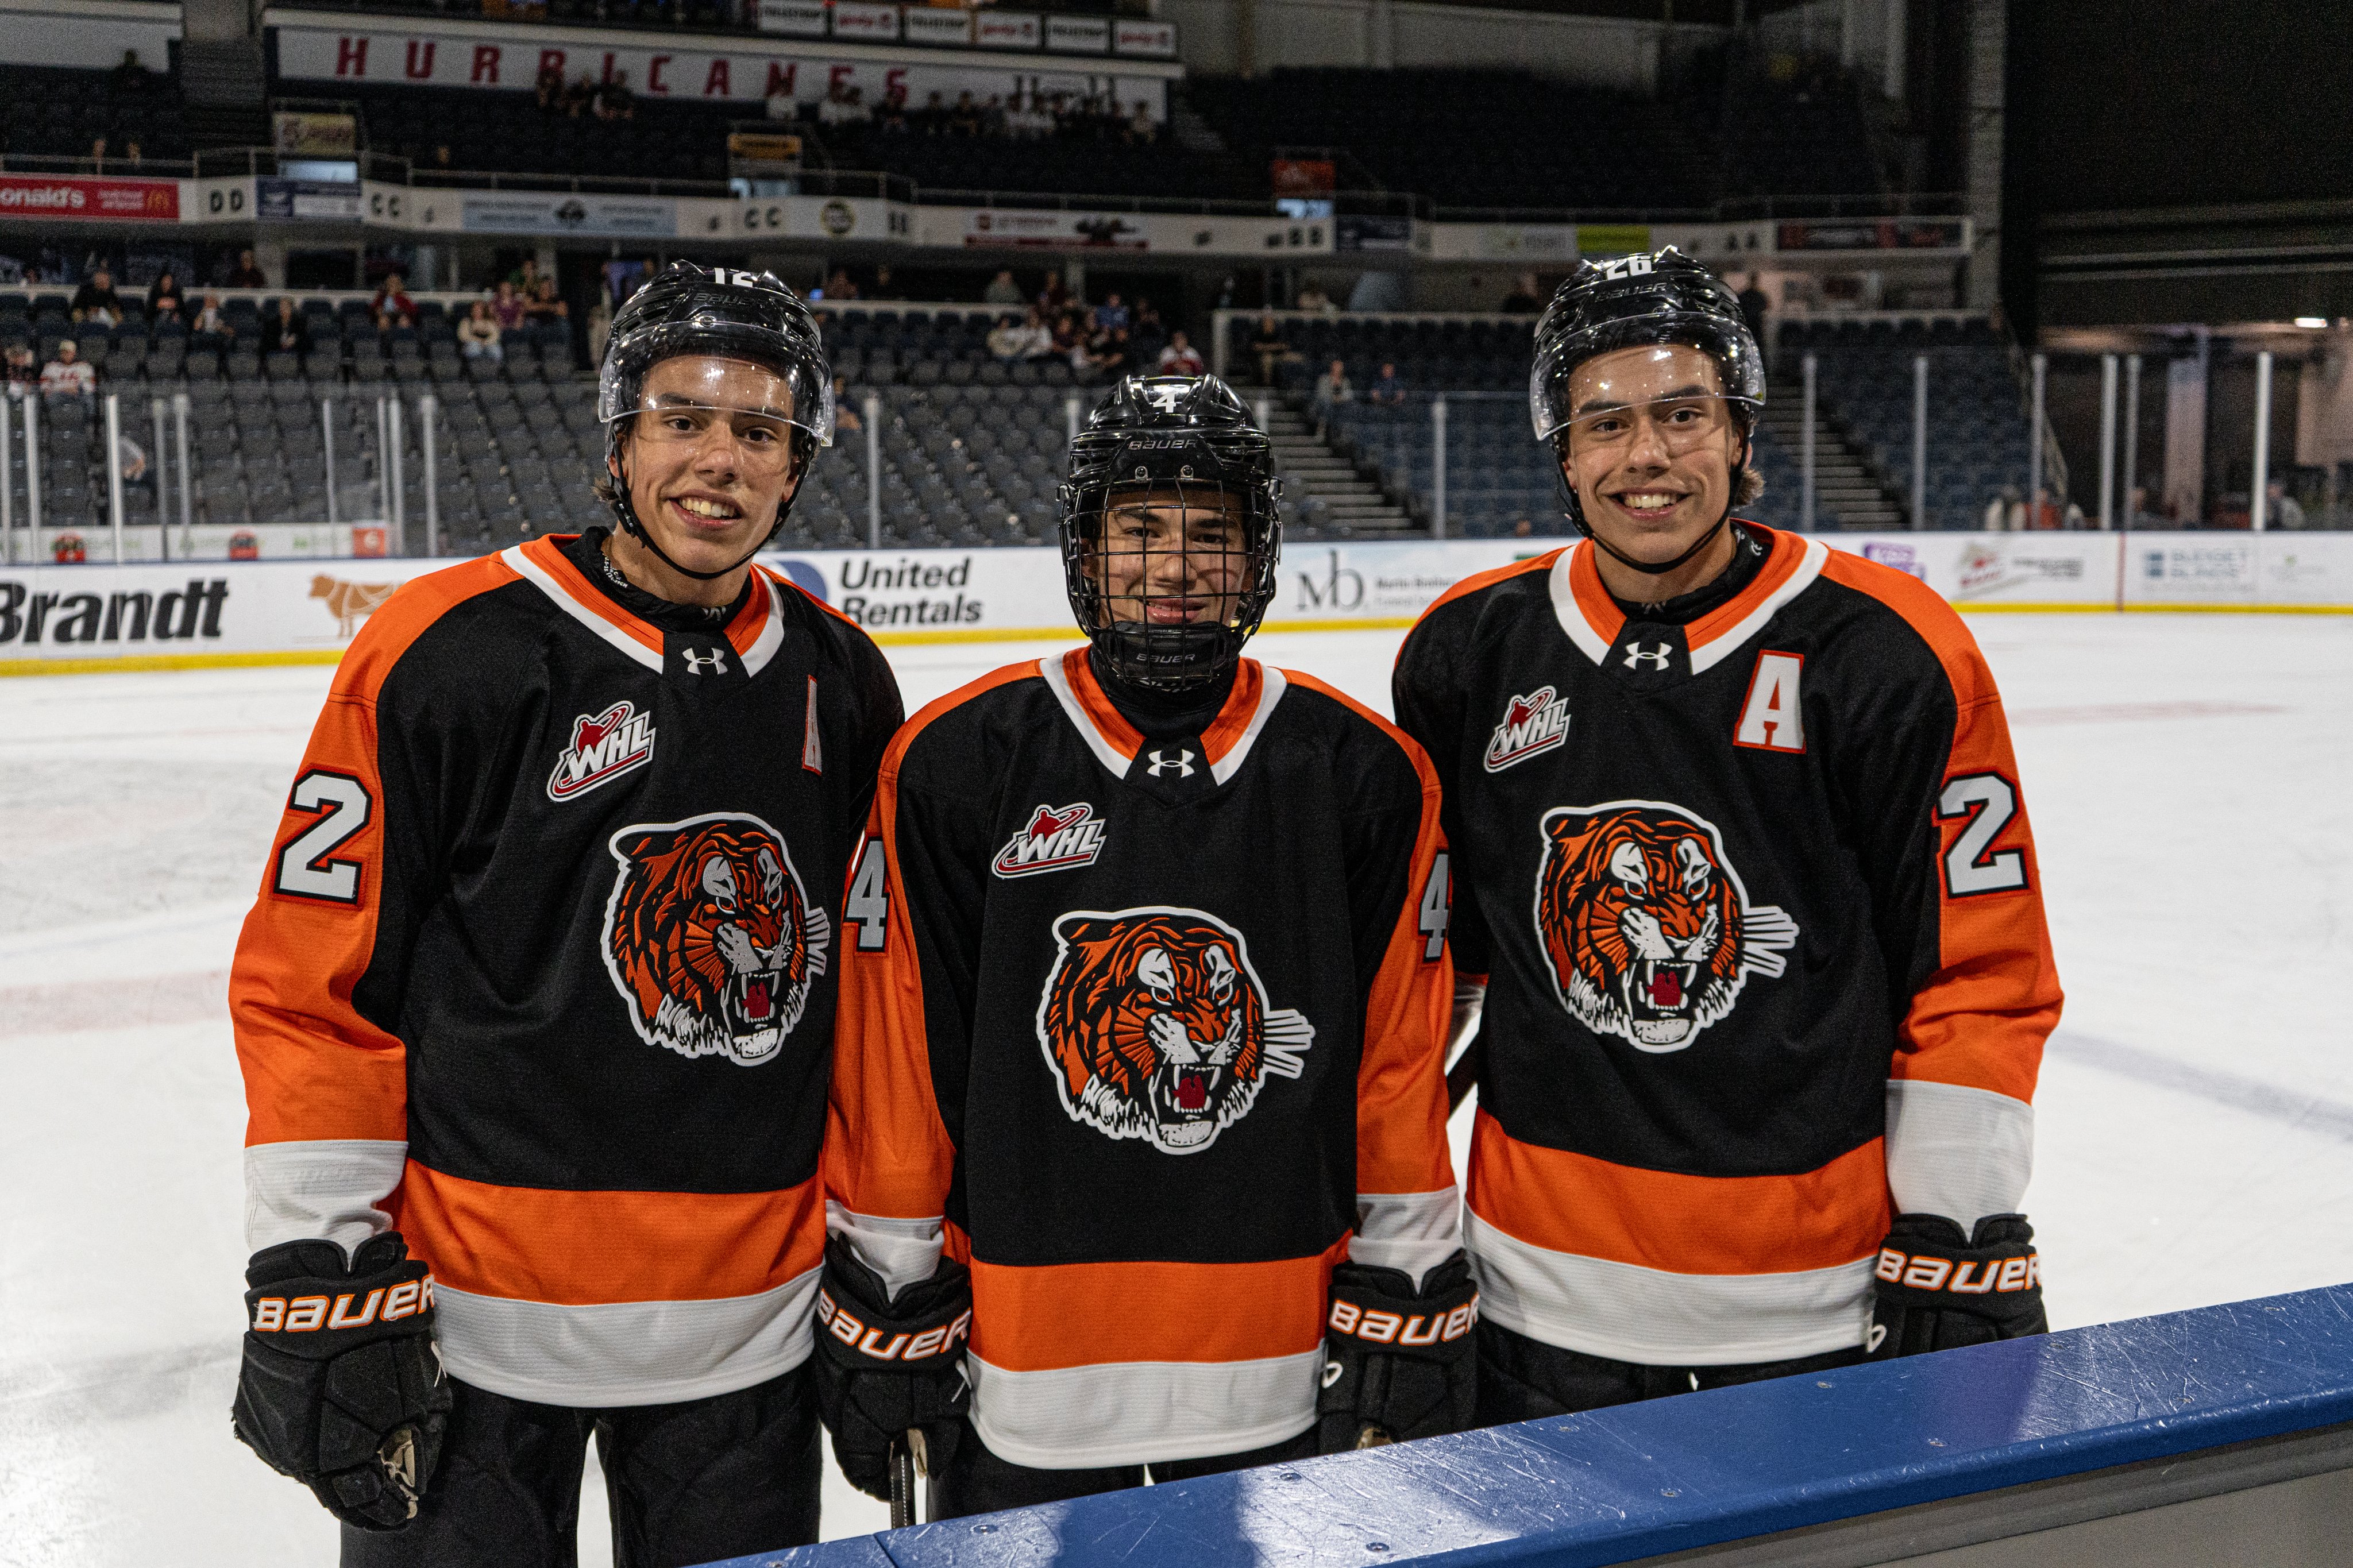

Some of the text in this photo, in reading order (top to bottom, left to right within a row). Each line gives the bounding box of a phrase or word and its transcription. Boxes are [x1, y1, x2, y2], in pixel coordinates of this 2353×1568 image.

[1152, 392, 1178, 413] 4
[840, 556, 971, 590] United
[0, 578, 228, 644] Brandt
[843, 593, 983, 627] Rentals
[1499, 705, 1566, 755] WHL
[1735, 651, 1805, 752] A
[566, 718, 651, 782] WHL
[275, 770, 371, 903] 2
[1018, 825, 1098, 863] WHL
[1938, 773, 2027, 897] 2
[845, 839, 889, 949] 4
[1418, 851, 1449, 960] 4
[1876, 1248, 2042, 1293] BAUER
[254, 1274, 435, 1333] BAUER
[817, 1288, 972, 1361] BAUER
[1329, 1292, 1480, 1346] BAUER
